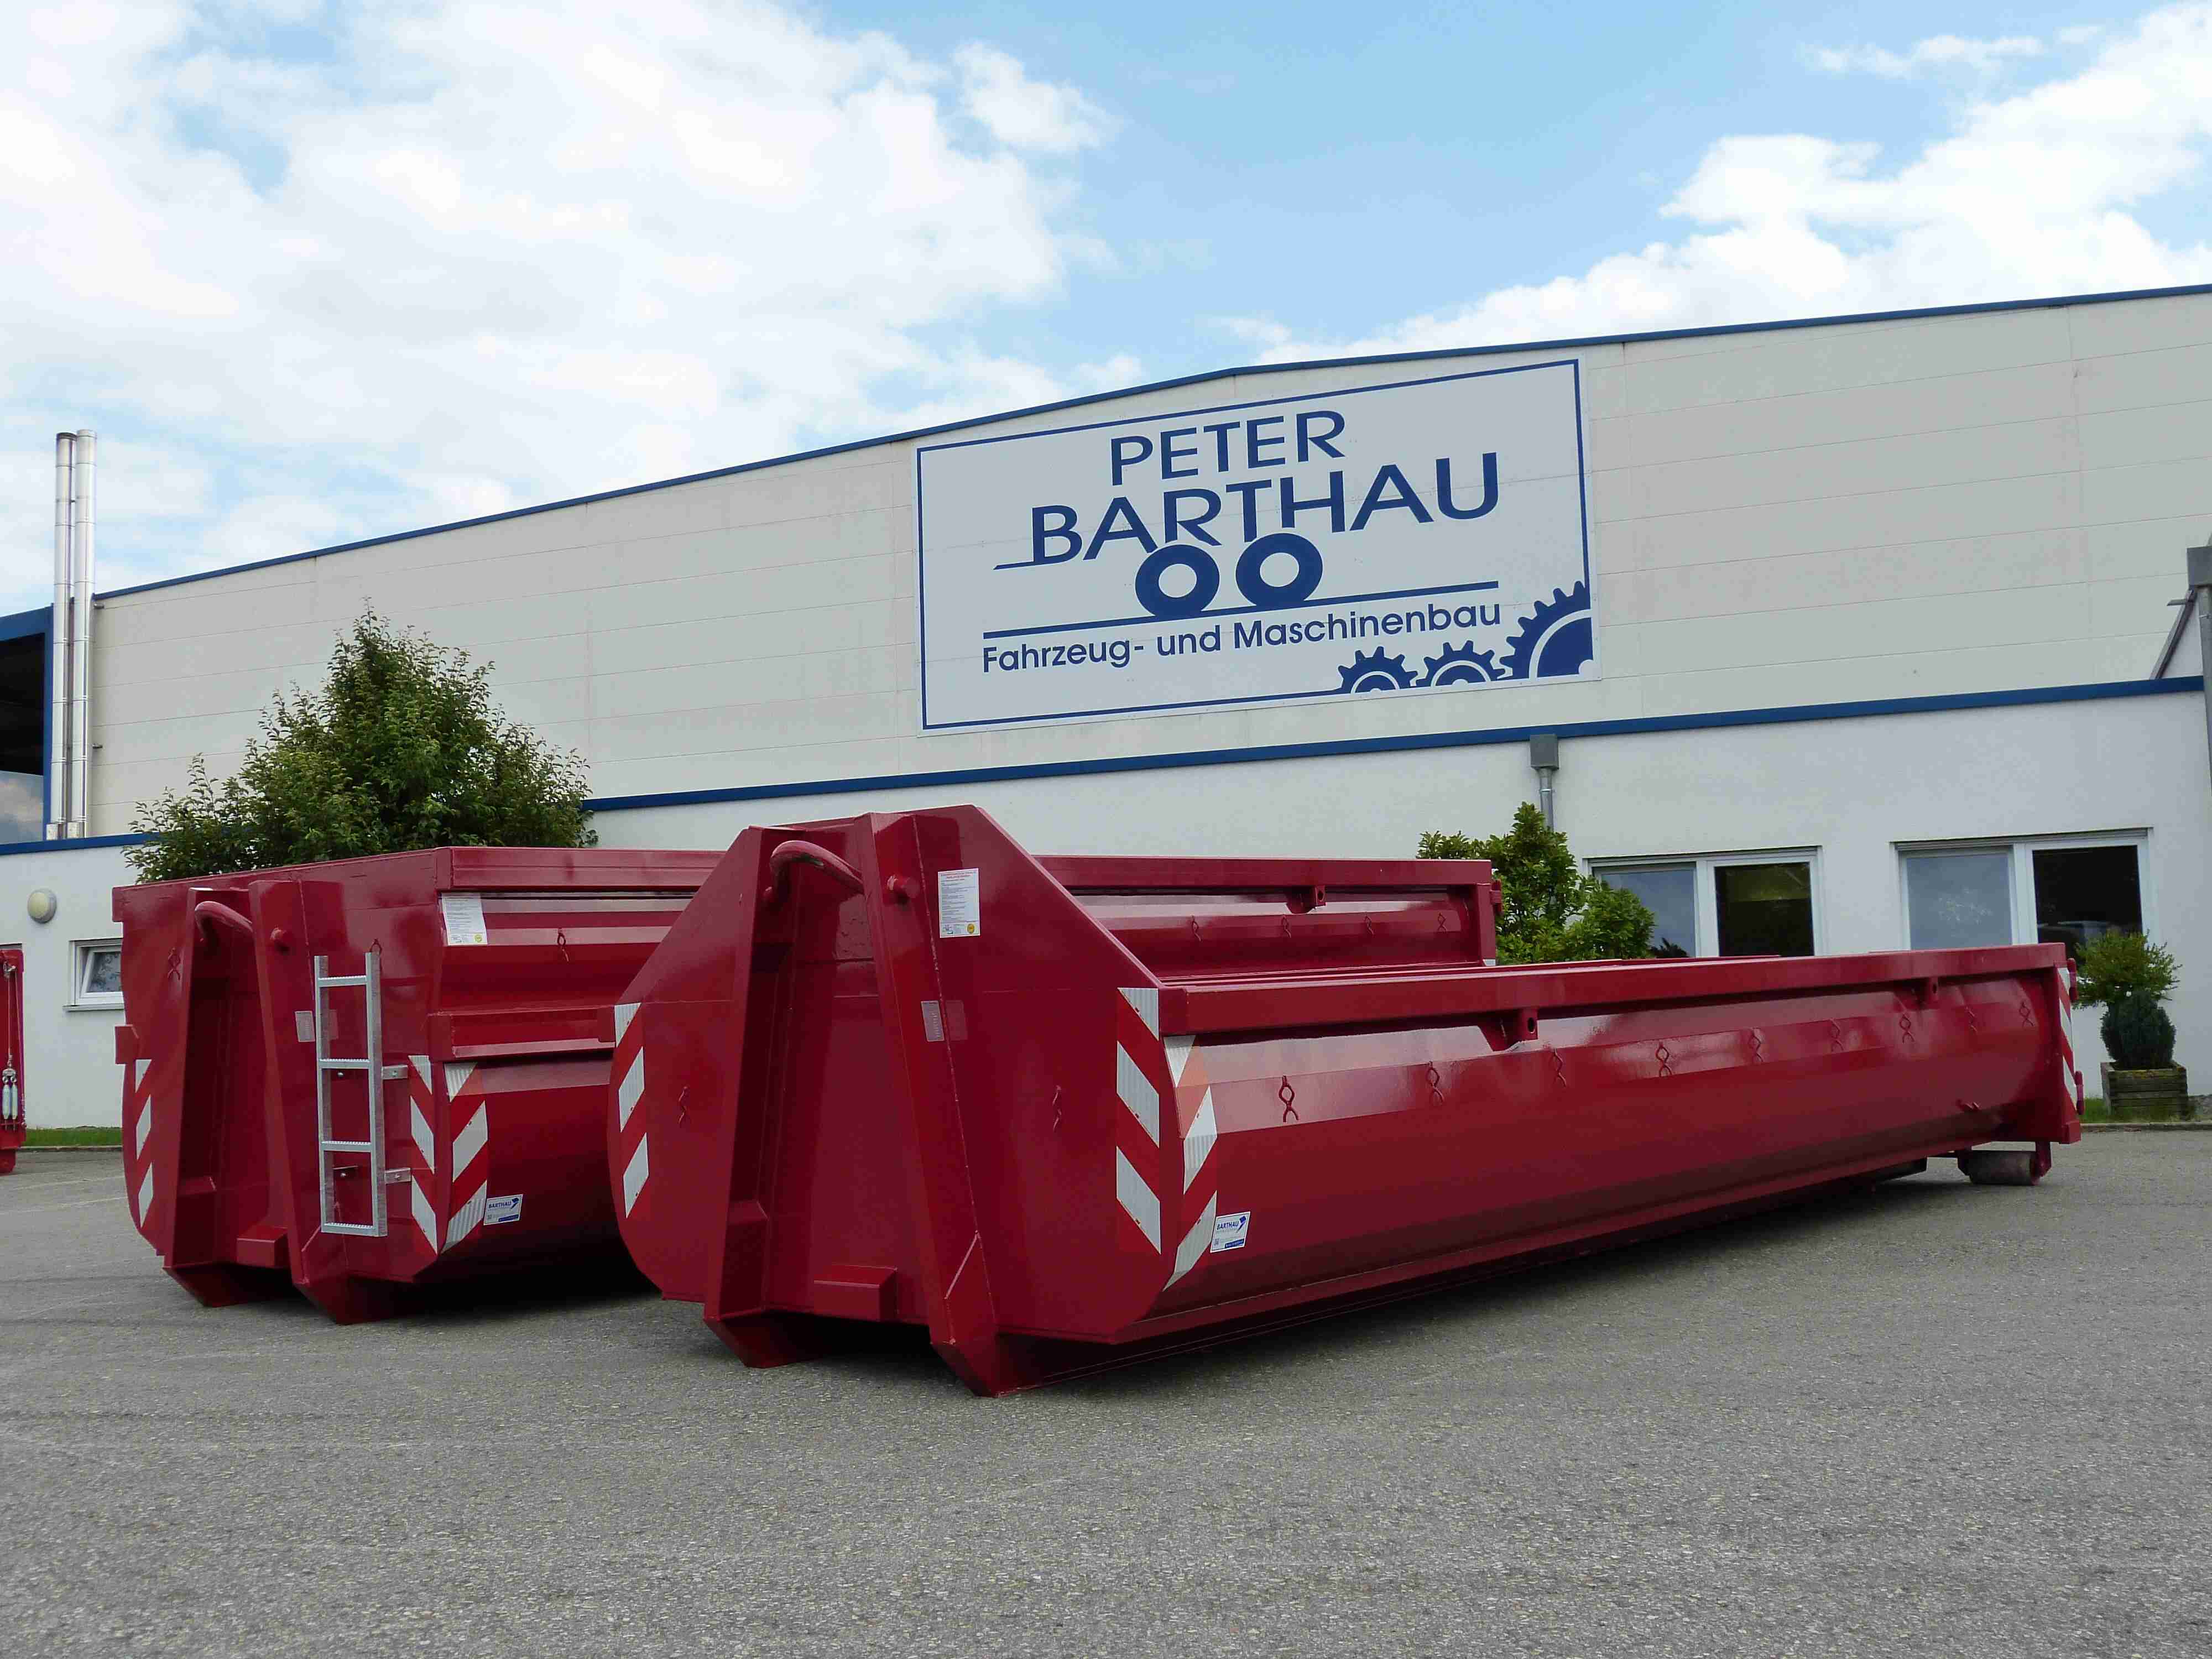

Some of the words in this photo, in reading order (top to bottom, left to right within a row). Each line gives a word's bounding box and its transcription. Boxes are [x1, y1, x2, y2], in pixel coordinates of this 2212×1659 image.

[1111, 410, 1345, 486] PETER
[994, 452, 1499, 569] BARTHAU
[983, 640, 1145, 673] Fahrzeug-
[1158, 624, 1222, 658] und
[1233, 602, 1501, 649] Maschinenbau
